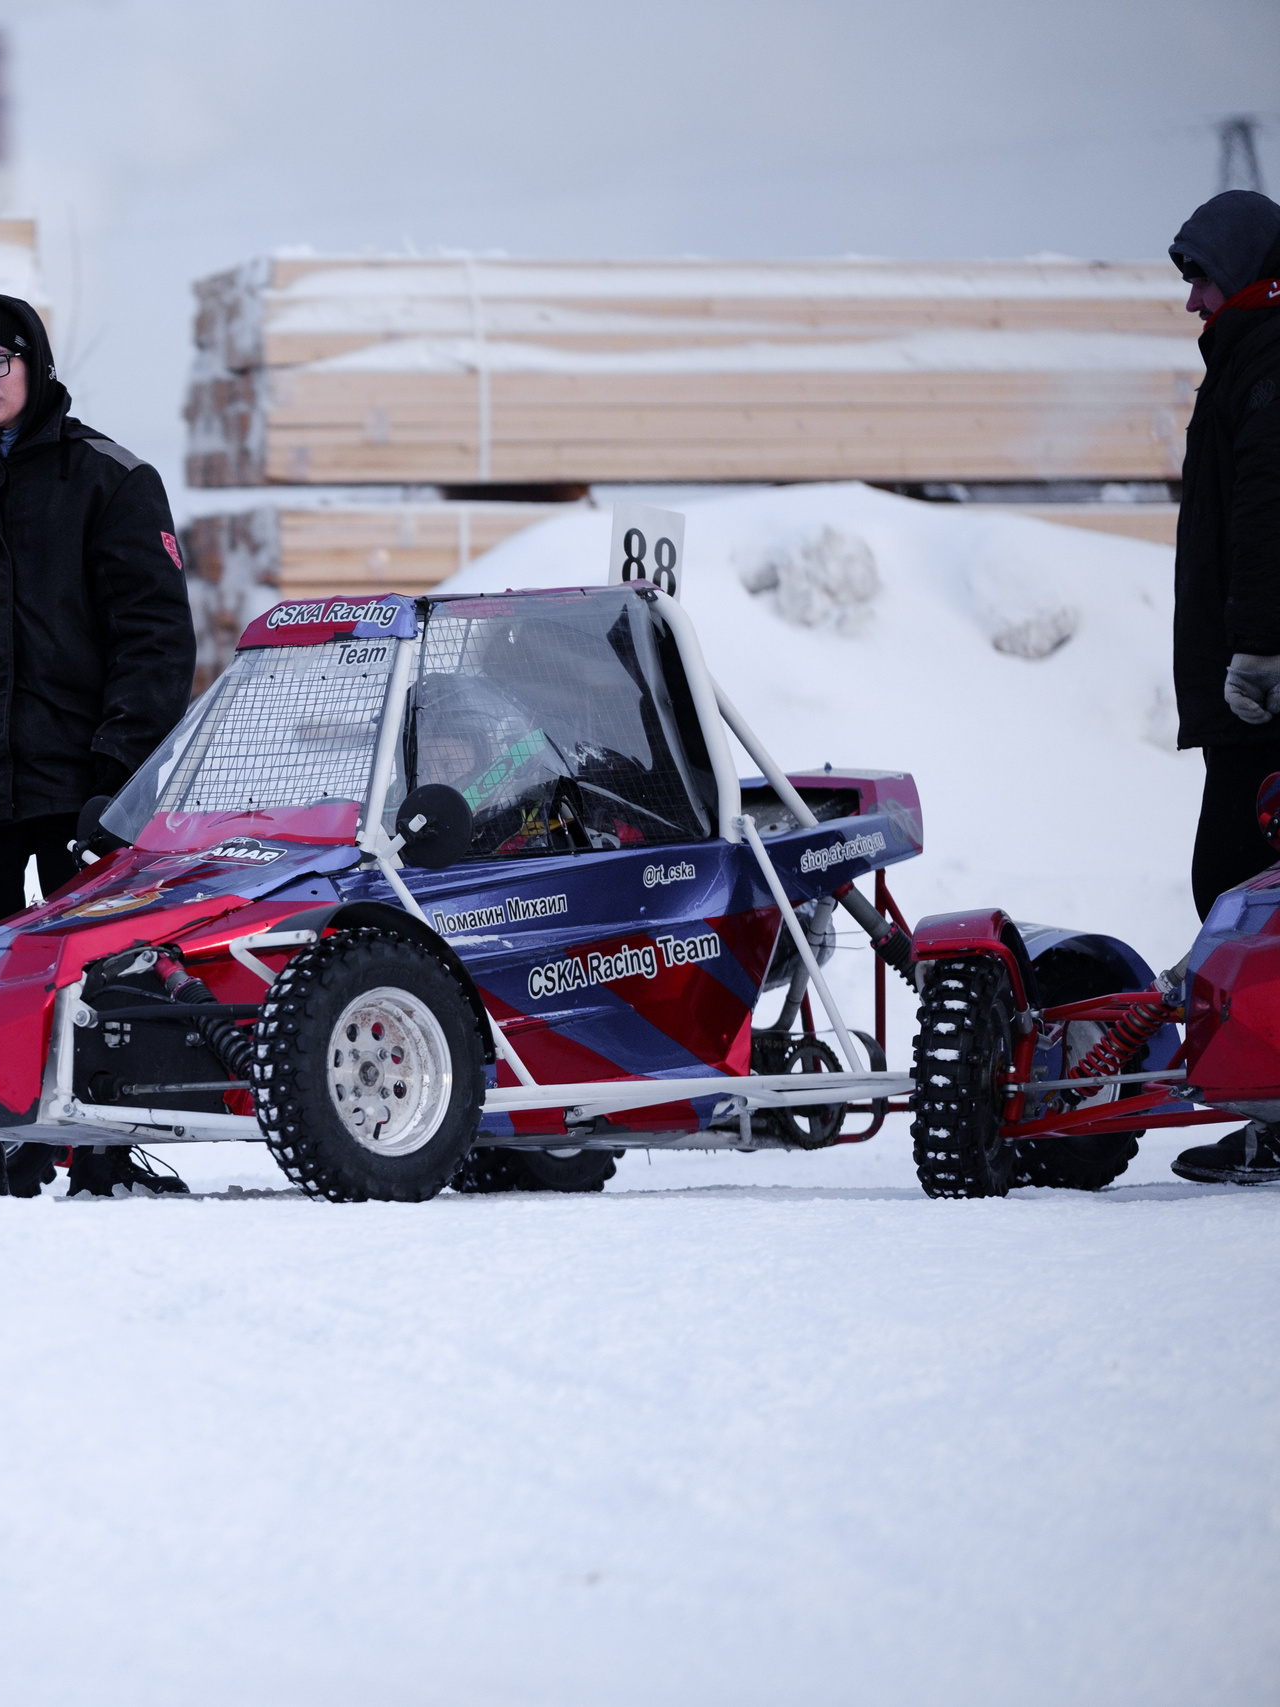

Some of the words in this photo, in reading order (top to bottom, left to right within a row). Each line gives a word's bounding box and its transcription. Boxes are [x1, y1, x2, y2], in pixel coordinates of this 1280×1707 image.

[622, 527, 677, 598] 88
[267, 603, 324, 628] CSKA
[323, 600, 400, 628] Racing
[338, 644, 388, 665] Team
[801, 832, 886, 873] shop.at-racing.ru
[644, 861, 695, 887] @rt_cska
[433, 907, 505, 935] Ломакин
[506, 894, 567, 922] Михаил
[528, 957, 587, 998] CSKA
[587, 945, 657, 985] Racing
[657, 933, 720, 967] Team
